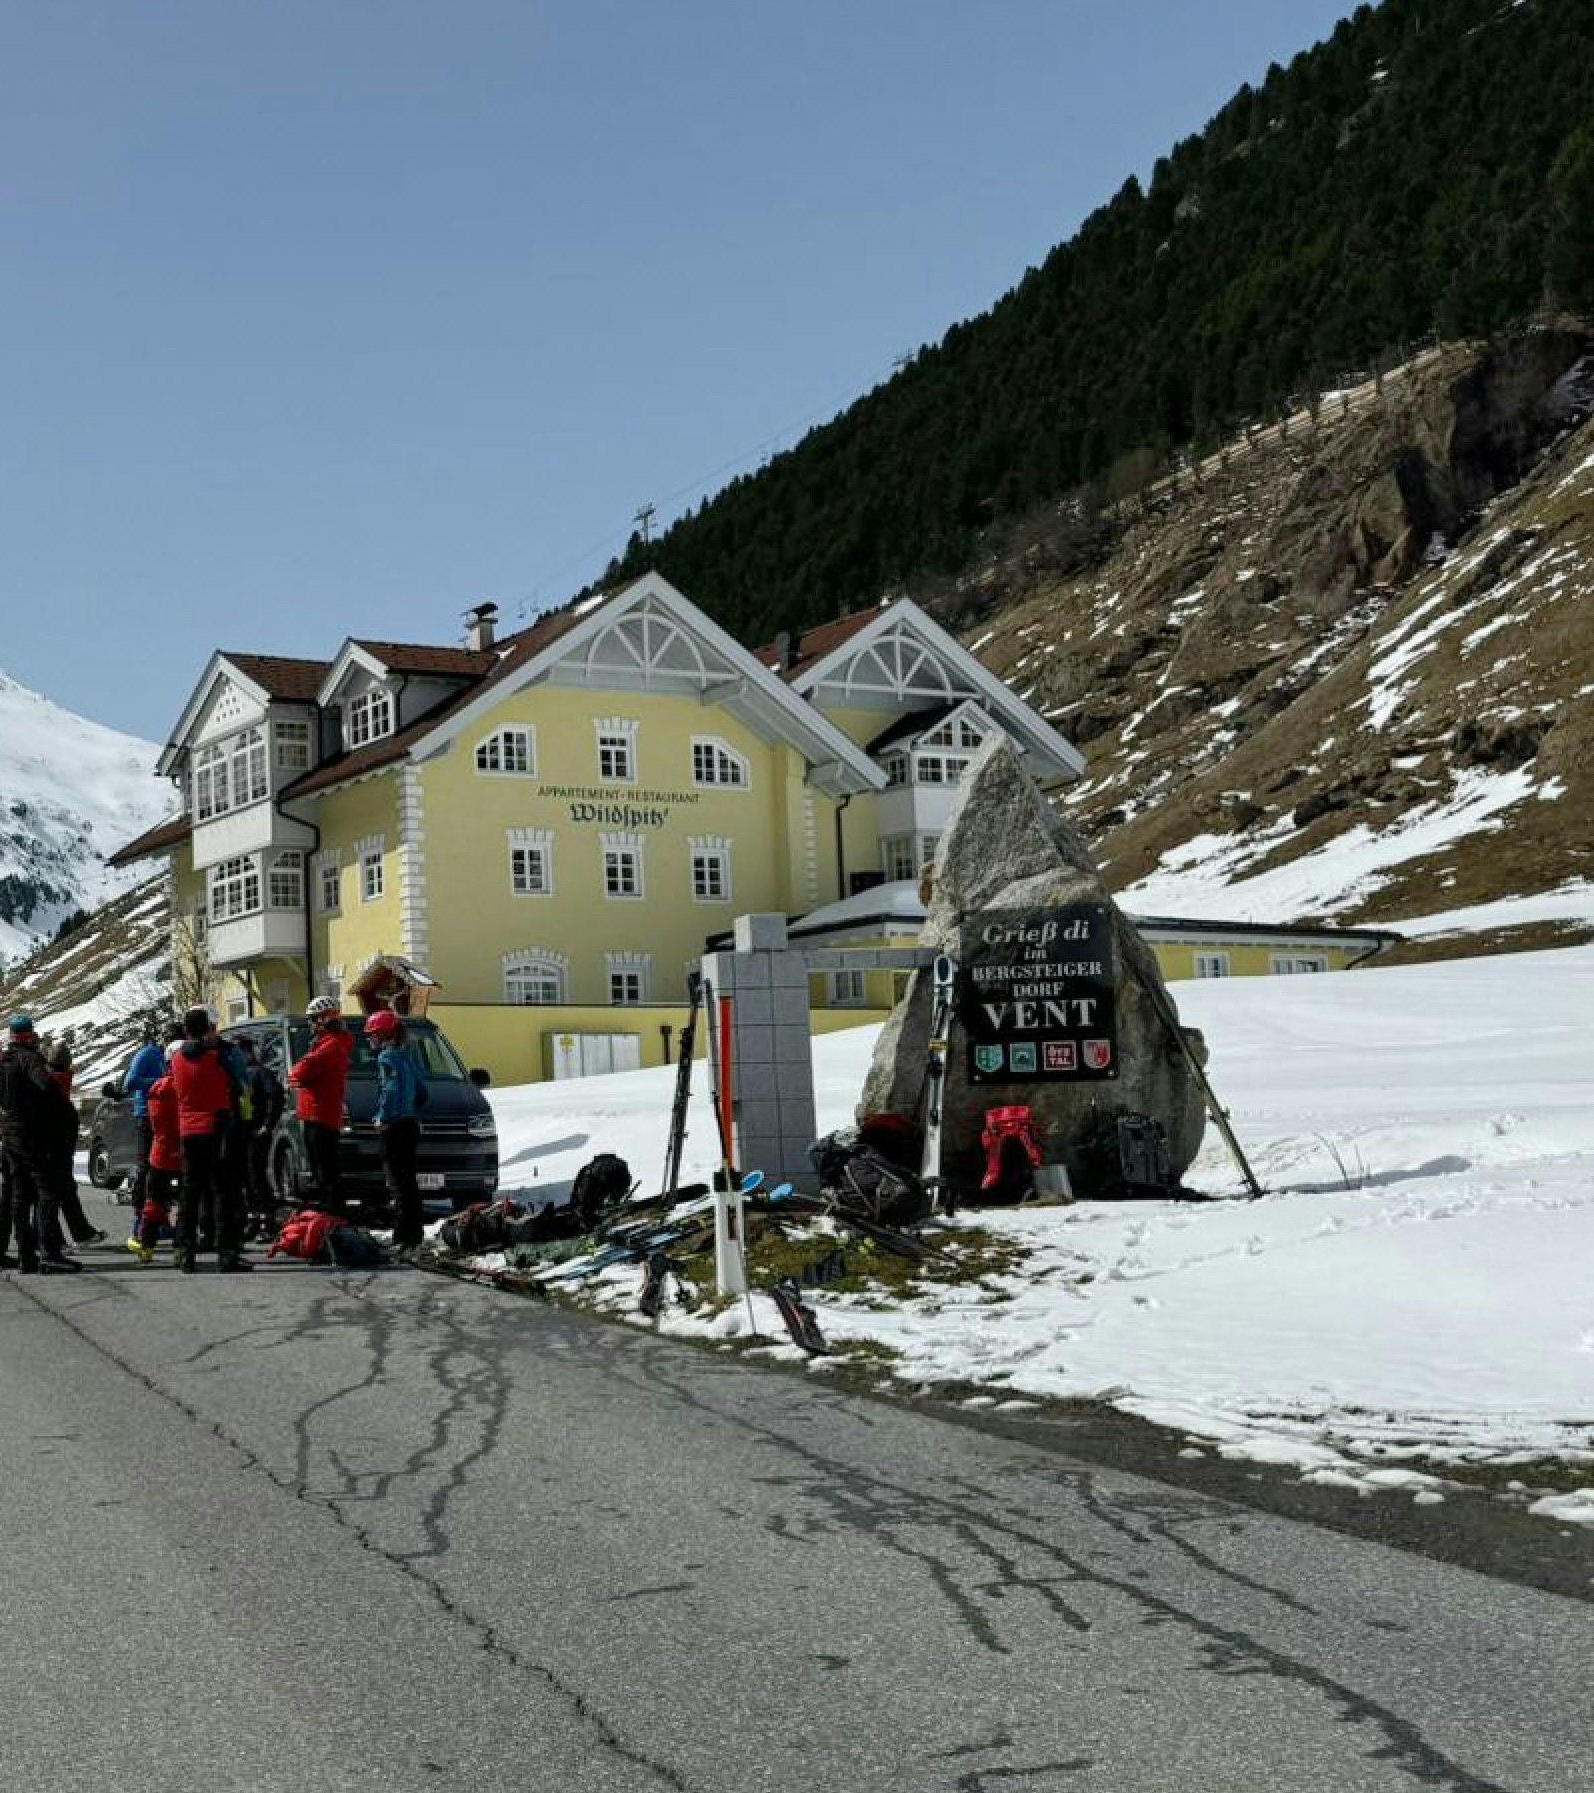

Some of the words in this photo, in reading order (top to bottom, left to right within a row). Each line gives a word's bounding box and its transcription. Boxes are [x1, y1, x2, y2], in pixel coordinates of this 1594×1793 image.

[538, 786, 620, 800] APPARTEMENT
[627, 790, 701, 804] RESTAURANT
[982, 921, 1058, 946] Grieß
[1063, 919, 1091, 941] di
[1024, 946, 1047, 960] im
[972, 961, 1103, 981] BERGSTEIGER
[1013, 981, 1065, 998] DORF
[981, 998, 1098, 1030] VENT
